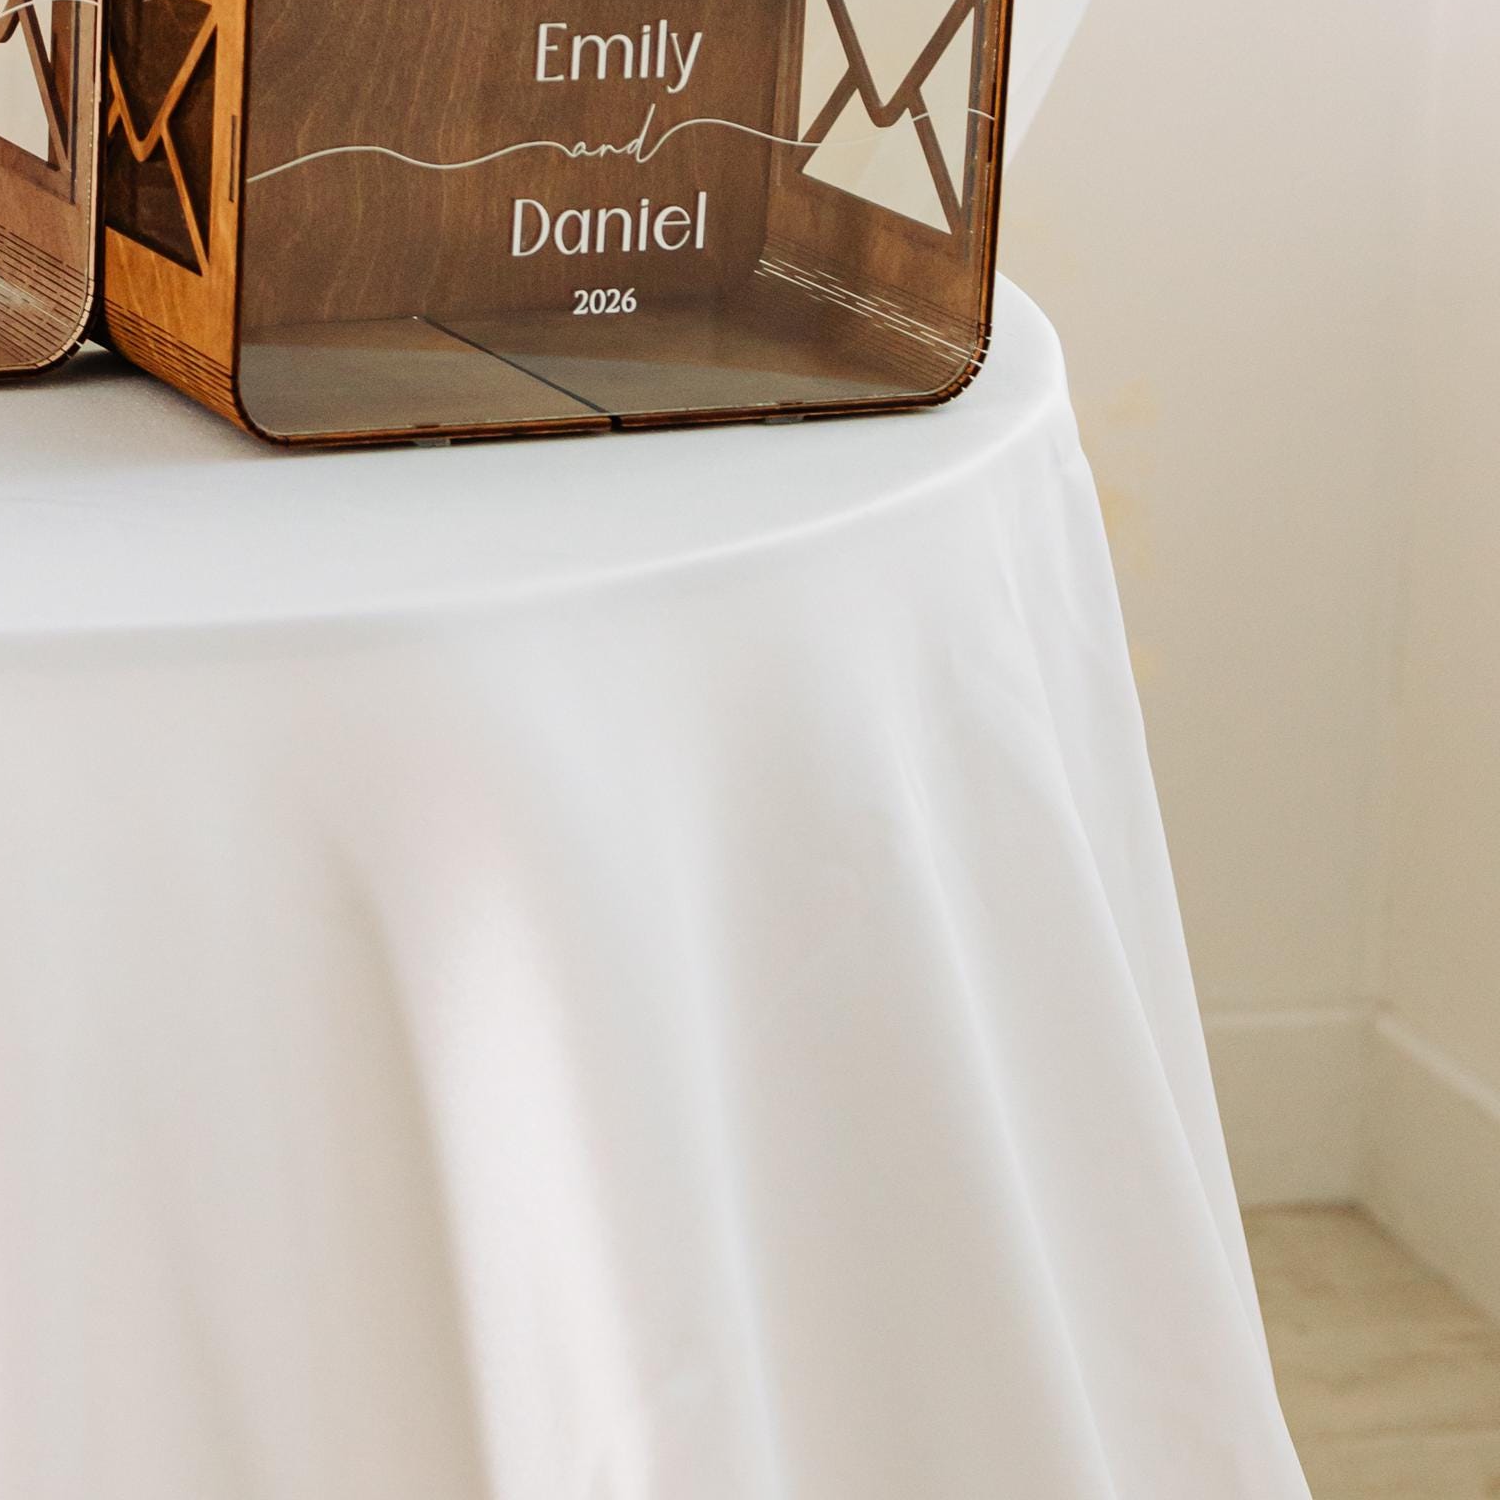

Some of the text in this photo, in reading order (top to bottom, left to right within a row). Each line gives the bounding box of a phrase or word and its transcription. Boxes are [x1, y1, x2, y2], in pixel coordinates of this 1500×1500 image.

[536, 19, 703, 93] Emily
[569, 103, 658, 163] and
[512, 191, 707, 256] Daniel
[572, 287, 637, 315] 2026
